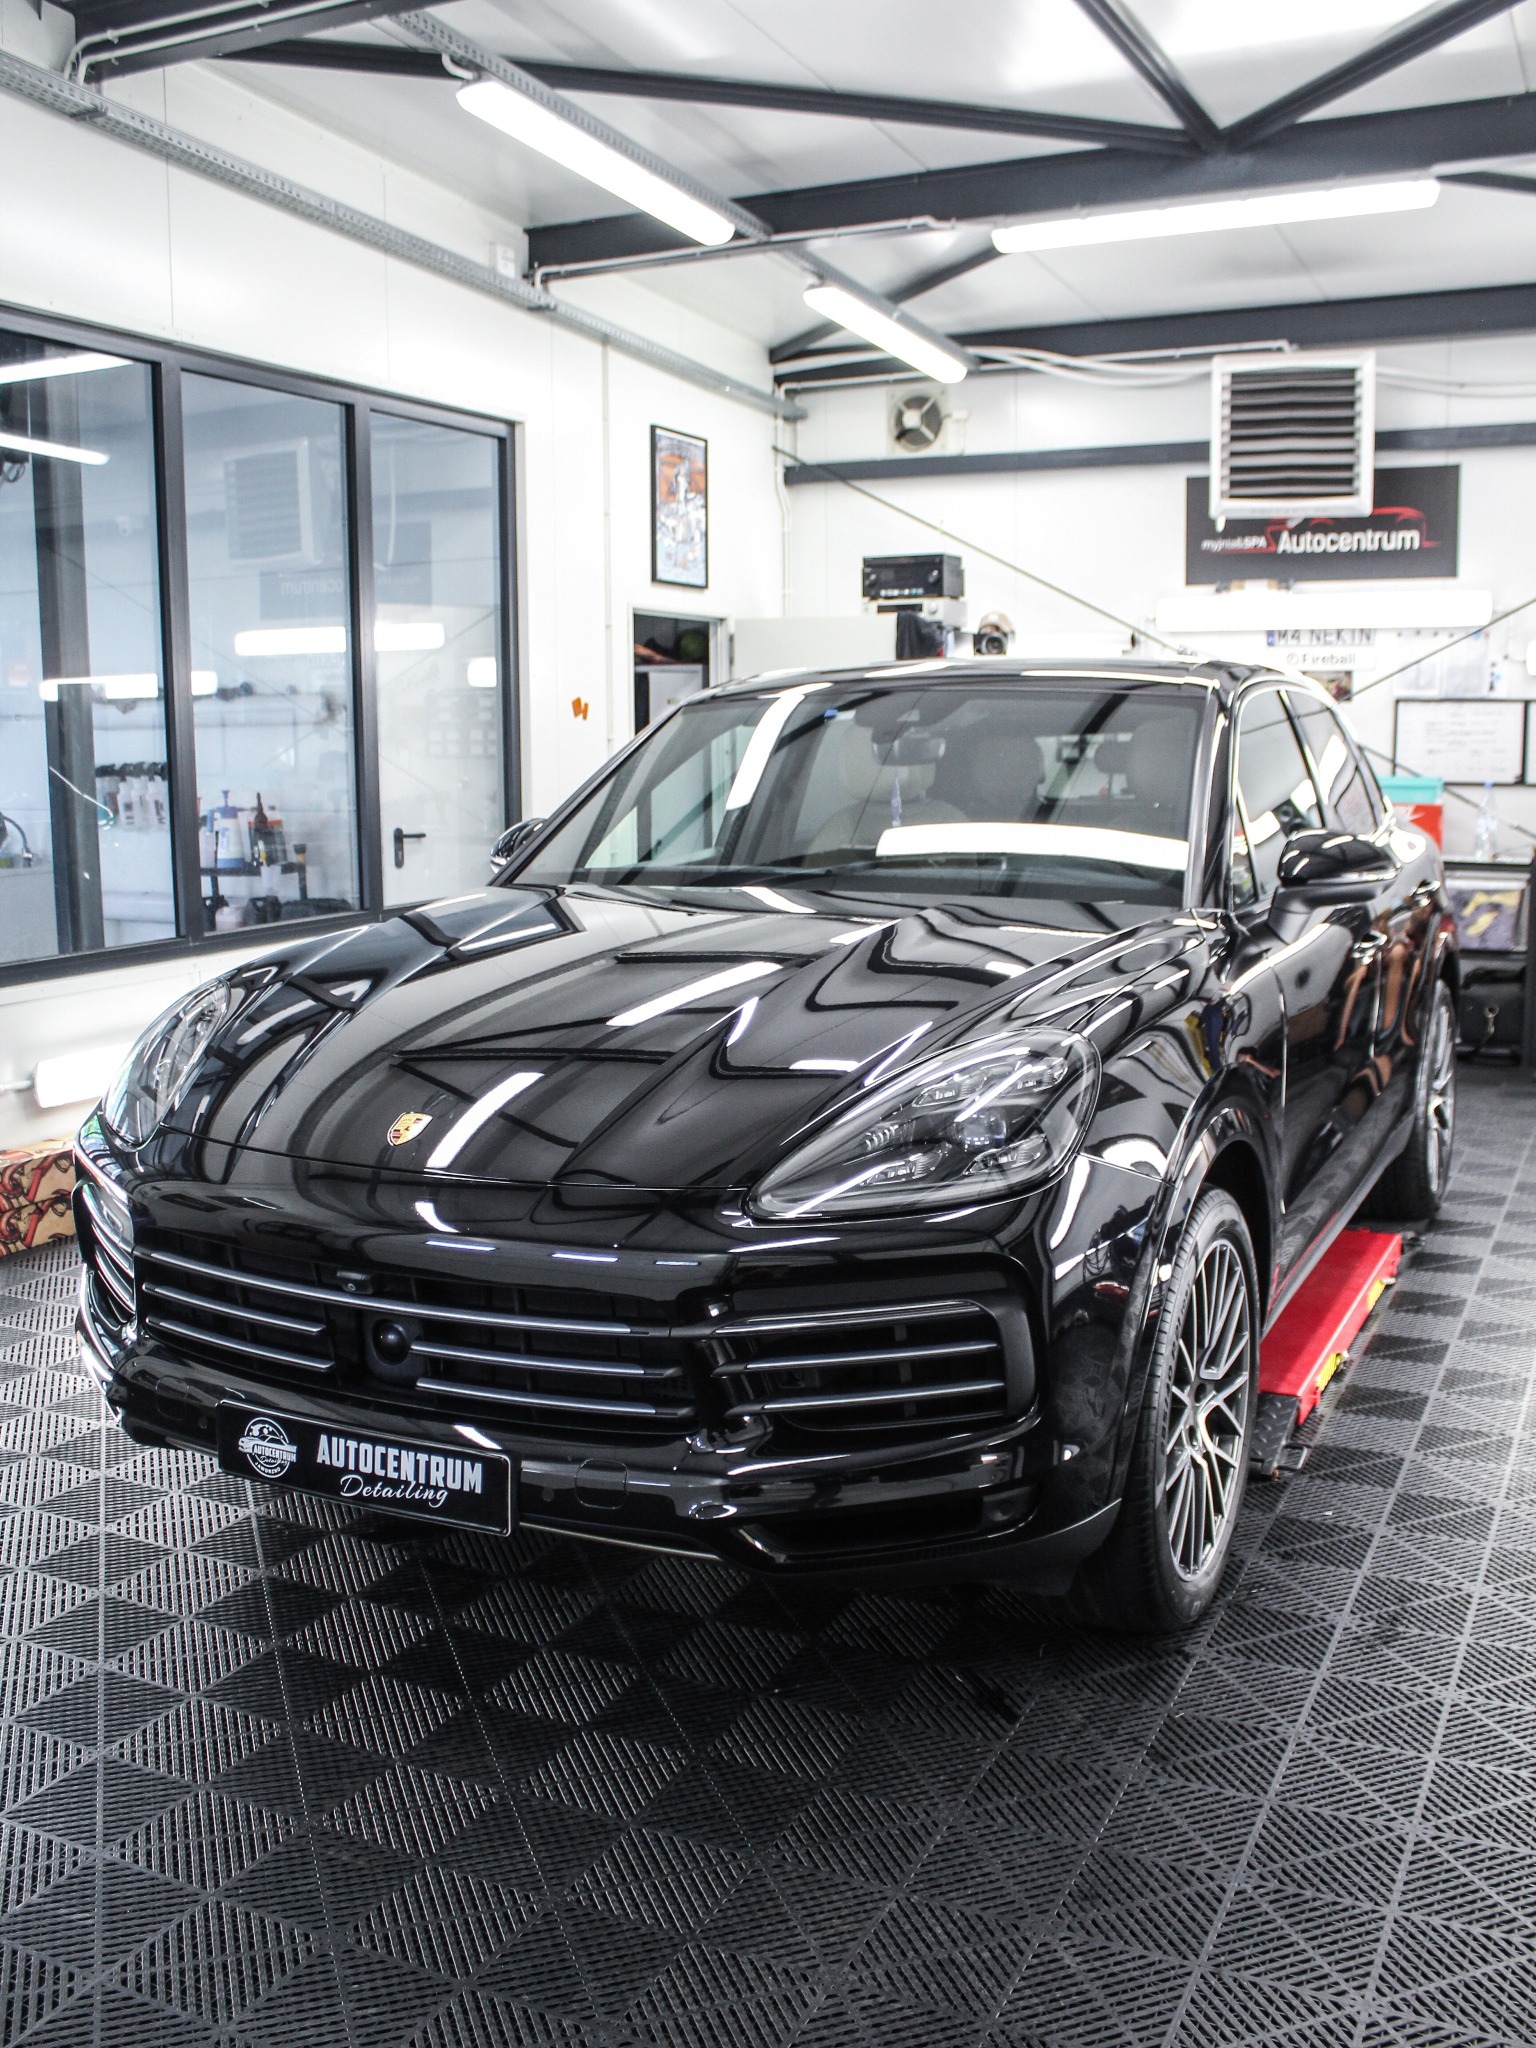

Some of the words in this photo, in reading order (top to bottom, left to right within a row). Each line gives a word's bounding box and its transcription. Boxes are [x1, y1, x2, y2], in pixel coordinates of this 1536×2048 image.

[1277, 528, 1420, 554] Autocentrum
[1302, 652, 1356, 665] Fireball
[253, 1444, 297, 1463] AUTOCENTRUM
[316, 1434, 482, 1494] AUTOCENTRUM
[340, 1474, 449, 1509] Detailing
